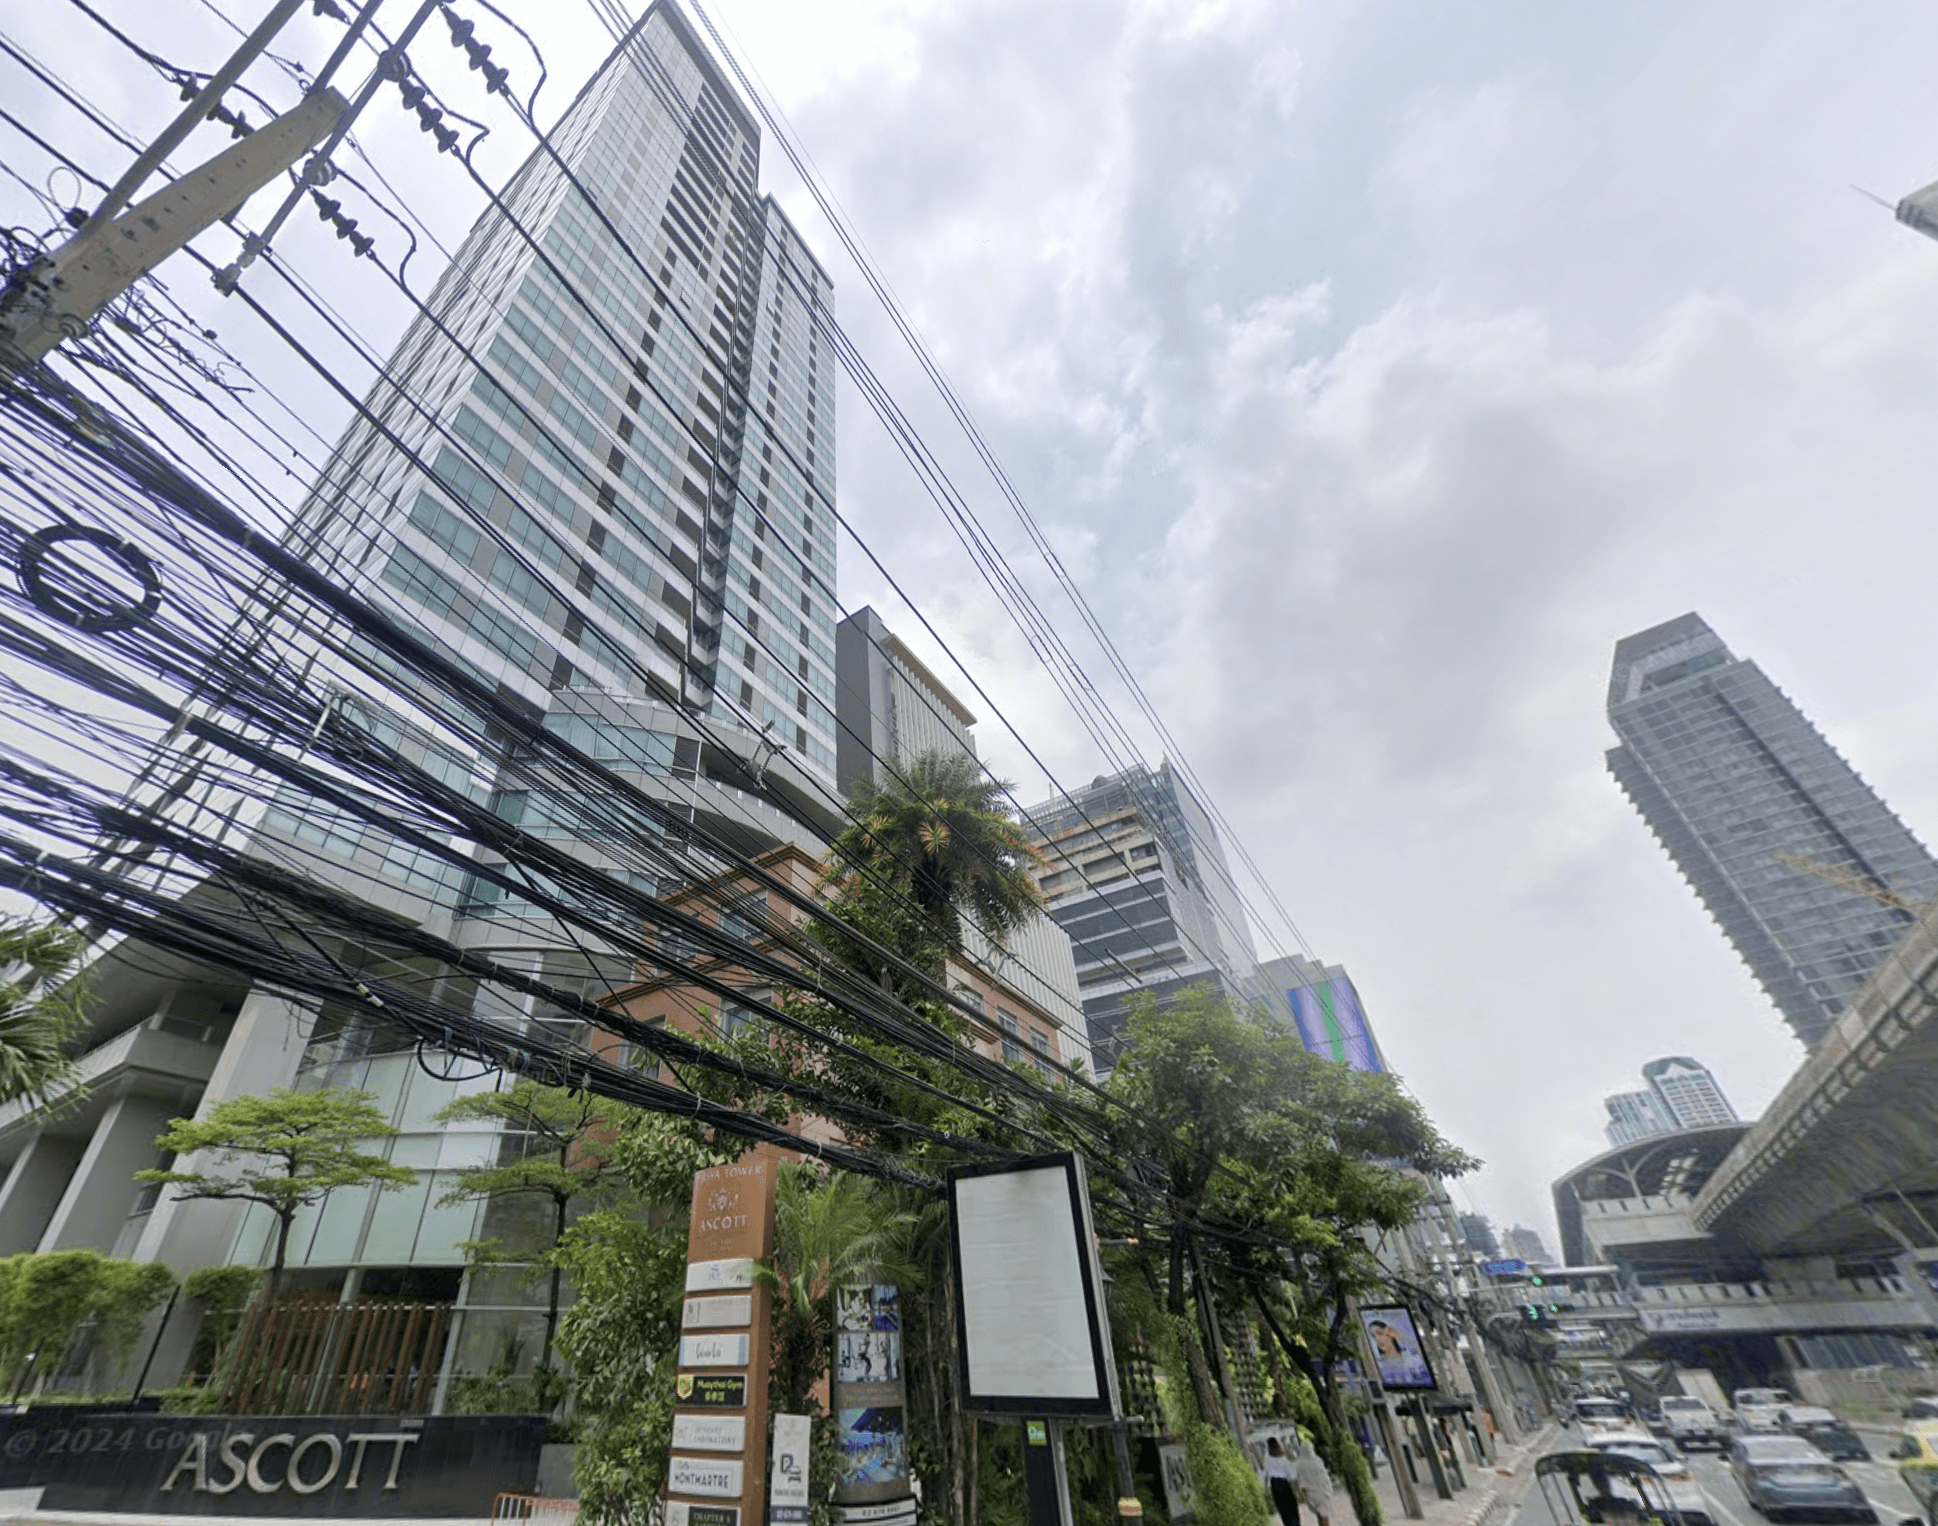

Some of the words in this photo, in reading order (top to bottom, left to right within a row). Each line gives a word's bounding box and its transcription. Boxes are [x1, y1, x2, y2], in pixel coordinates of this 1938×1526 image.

[725, 1165, 762, 1178] TOWER
[699, 1214, 748, 1232] ASCOTT
[160, 1432, 421, 1495] ASCOTT
[674, 1471, 729, 1489] MONTMARTRE
